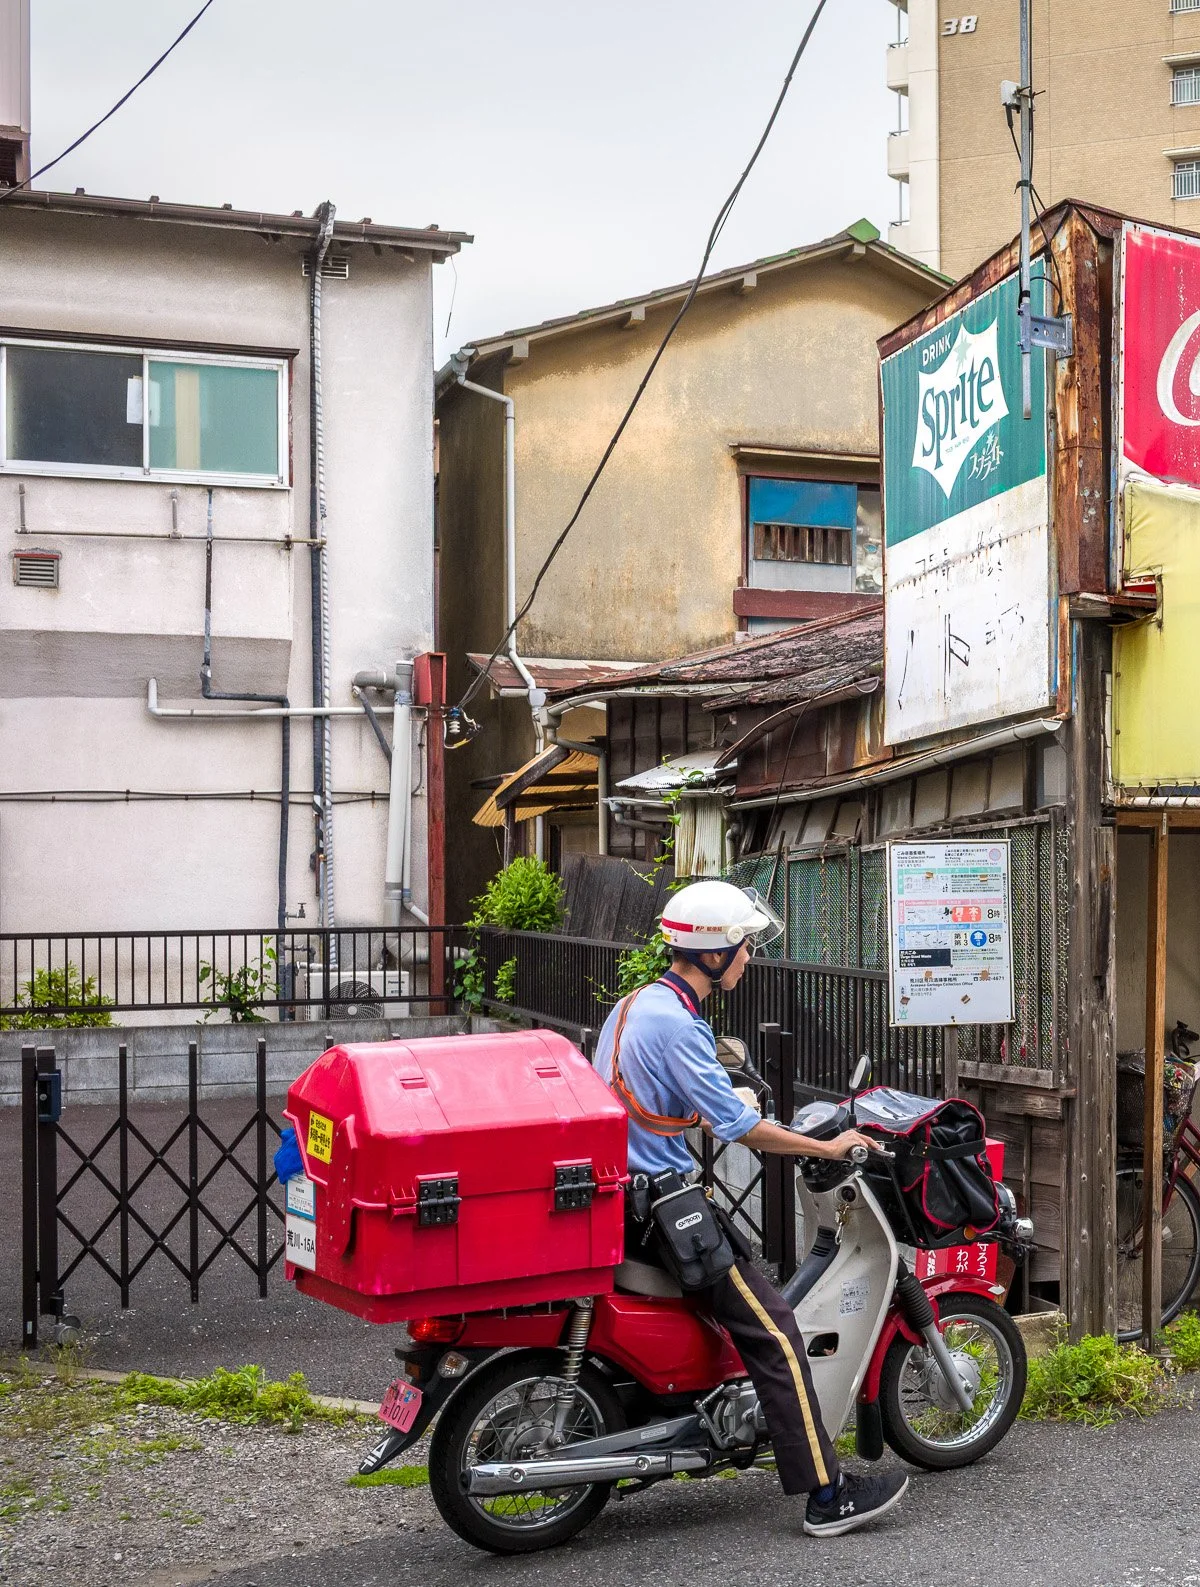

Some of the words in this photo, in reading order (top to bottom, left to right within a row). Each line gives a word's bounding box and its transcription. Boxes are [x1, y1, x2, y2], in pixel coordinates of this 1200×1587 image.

[941, 15, 978, 36] 38
[922, 333, 951, 366] DRINK
[922, 356, 995, 470] Sprite
[286, 1229, 316, 1253] 荒川-15A
